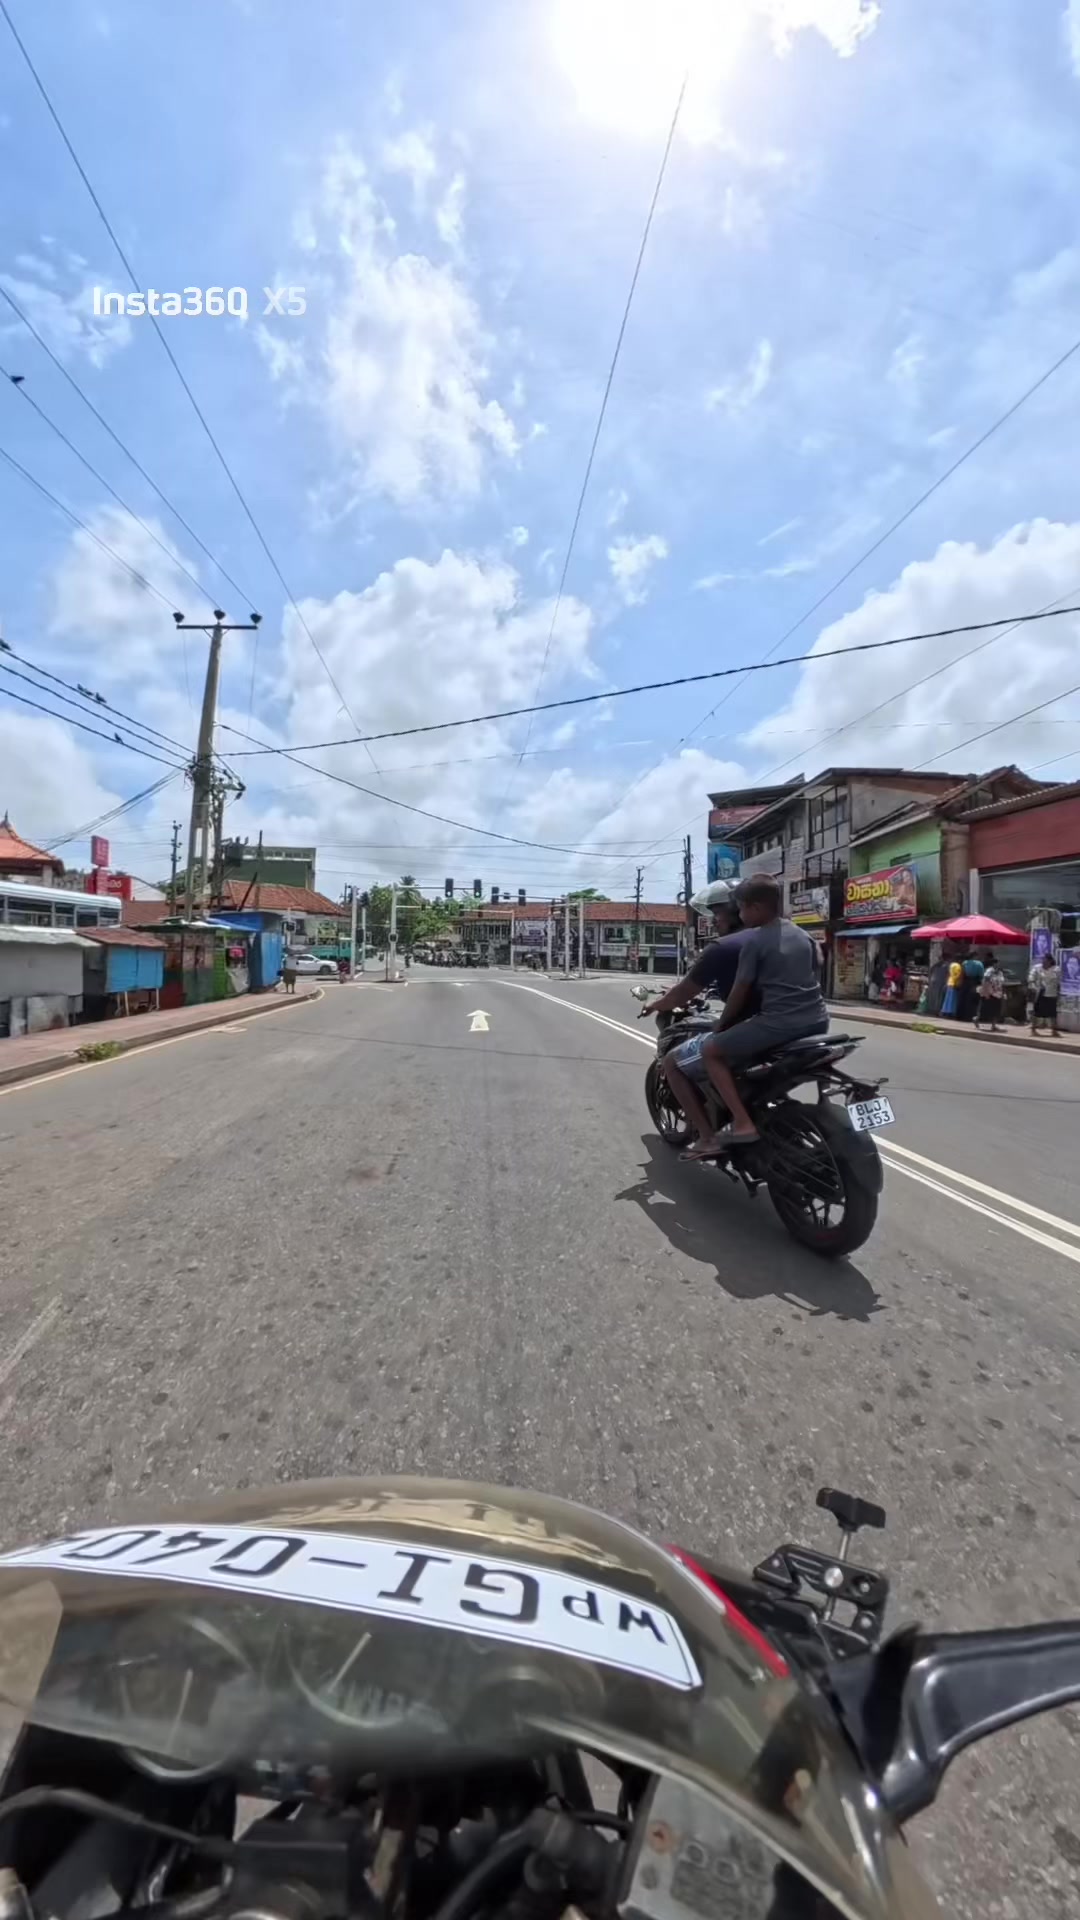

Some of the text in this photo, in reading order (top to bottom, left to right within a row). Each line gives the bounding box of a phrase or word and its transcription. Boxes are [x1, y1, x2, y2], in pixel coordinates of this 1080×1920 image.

[855, 1100, 882, 1116] BLJ
[857, 1111, 891, 1129] 2153
[61, 1530, 669, 1647] WP GI-040
